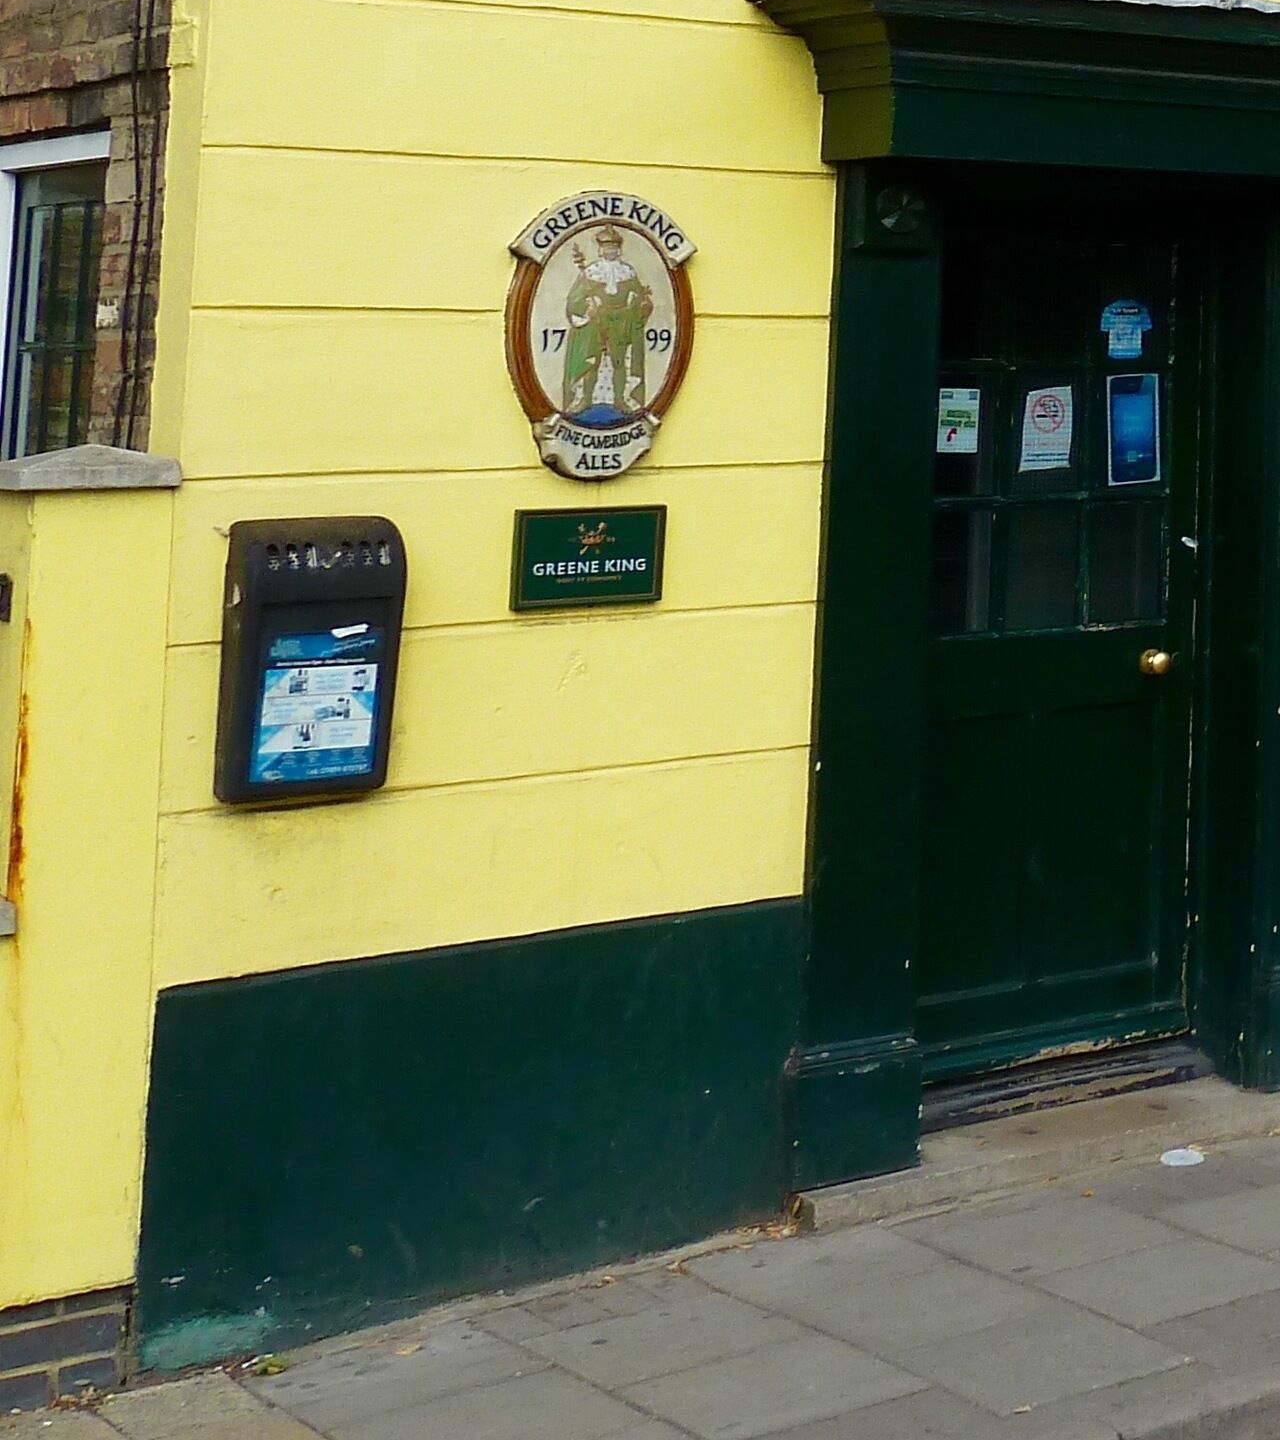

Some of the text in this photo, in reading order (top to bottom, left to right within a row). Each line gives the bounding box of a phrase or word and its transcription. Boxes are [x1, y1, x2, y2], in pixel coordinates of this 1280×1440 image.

[532, 197, 684, 252] GREENE KING
[542, 328, 671, 352] 17 99
[555, 423, 647, 449] FINE CAMBRIDGE
[575, 453, 622, 470] ALES
[533, 558, 646, 576] GREENE KING
